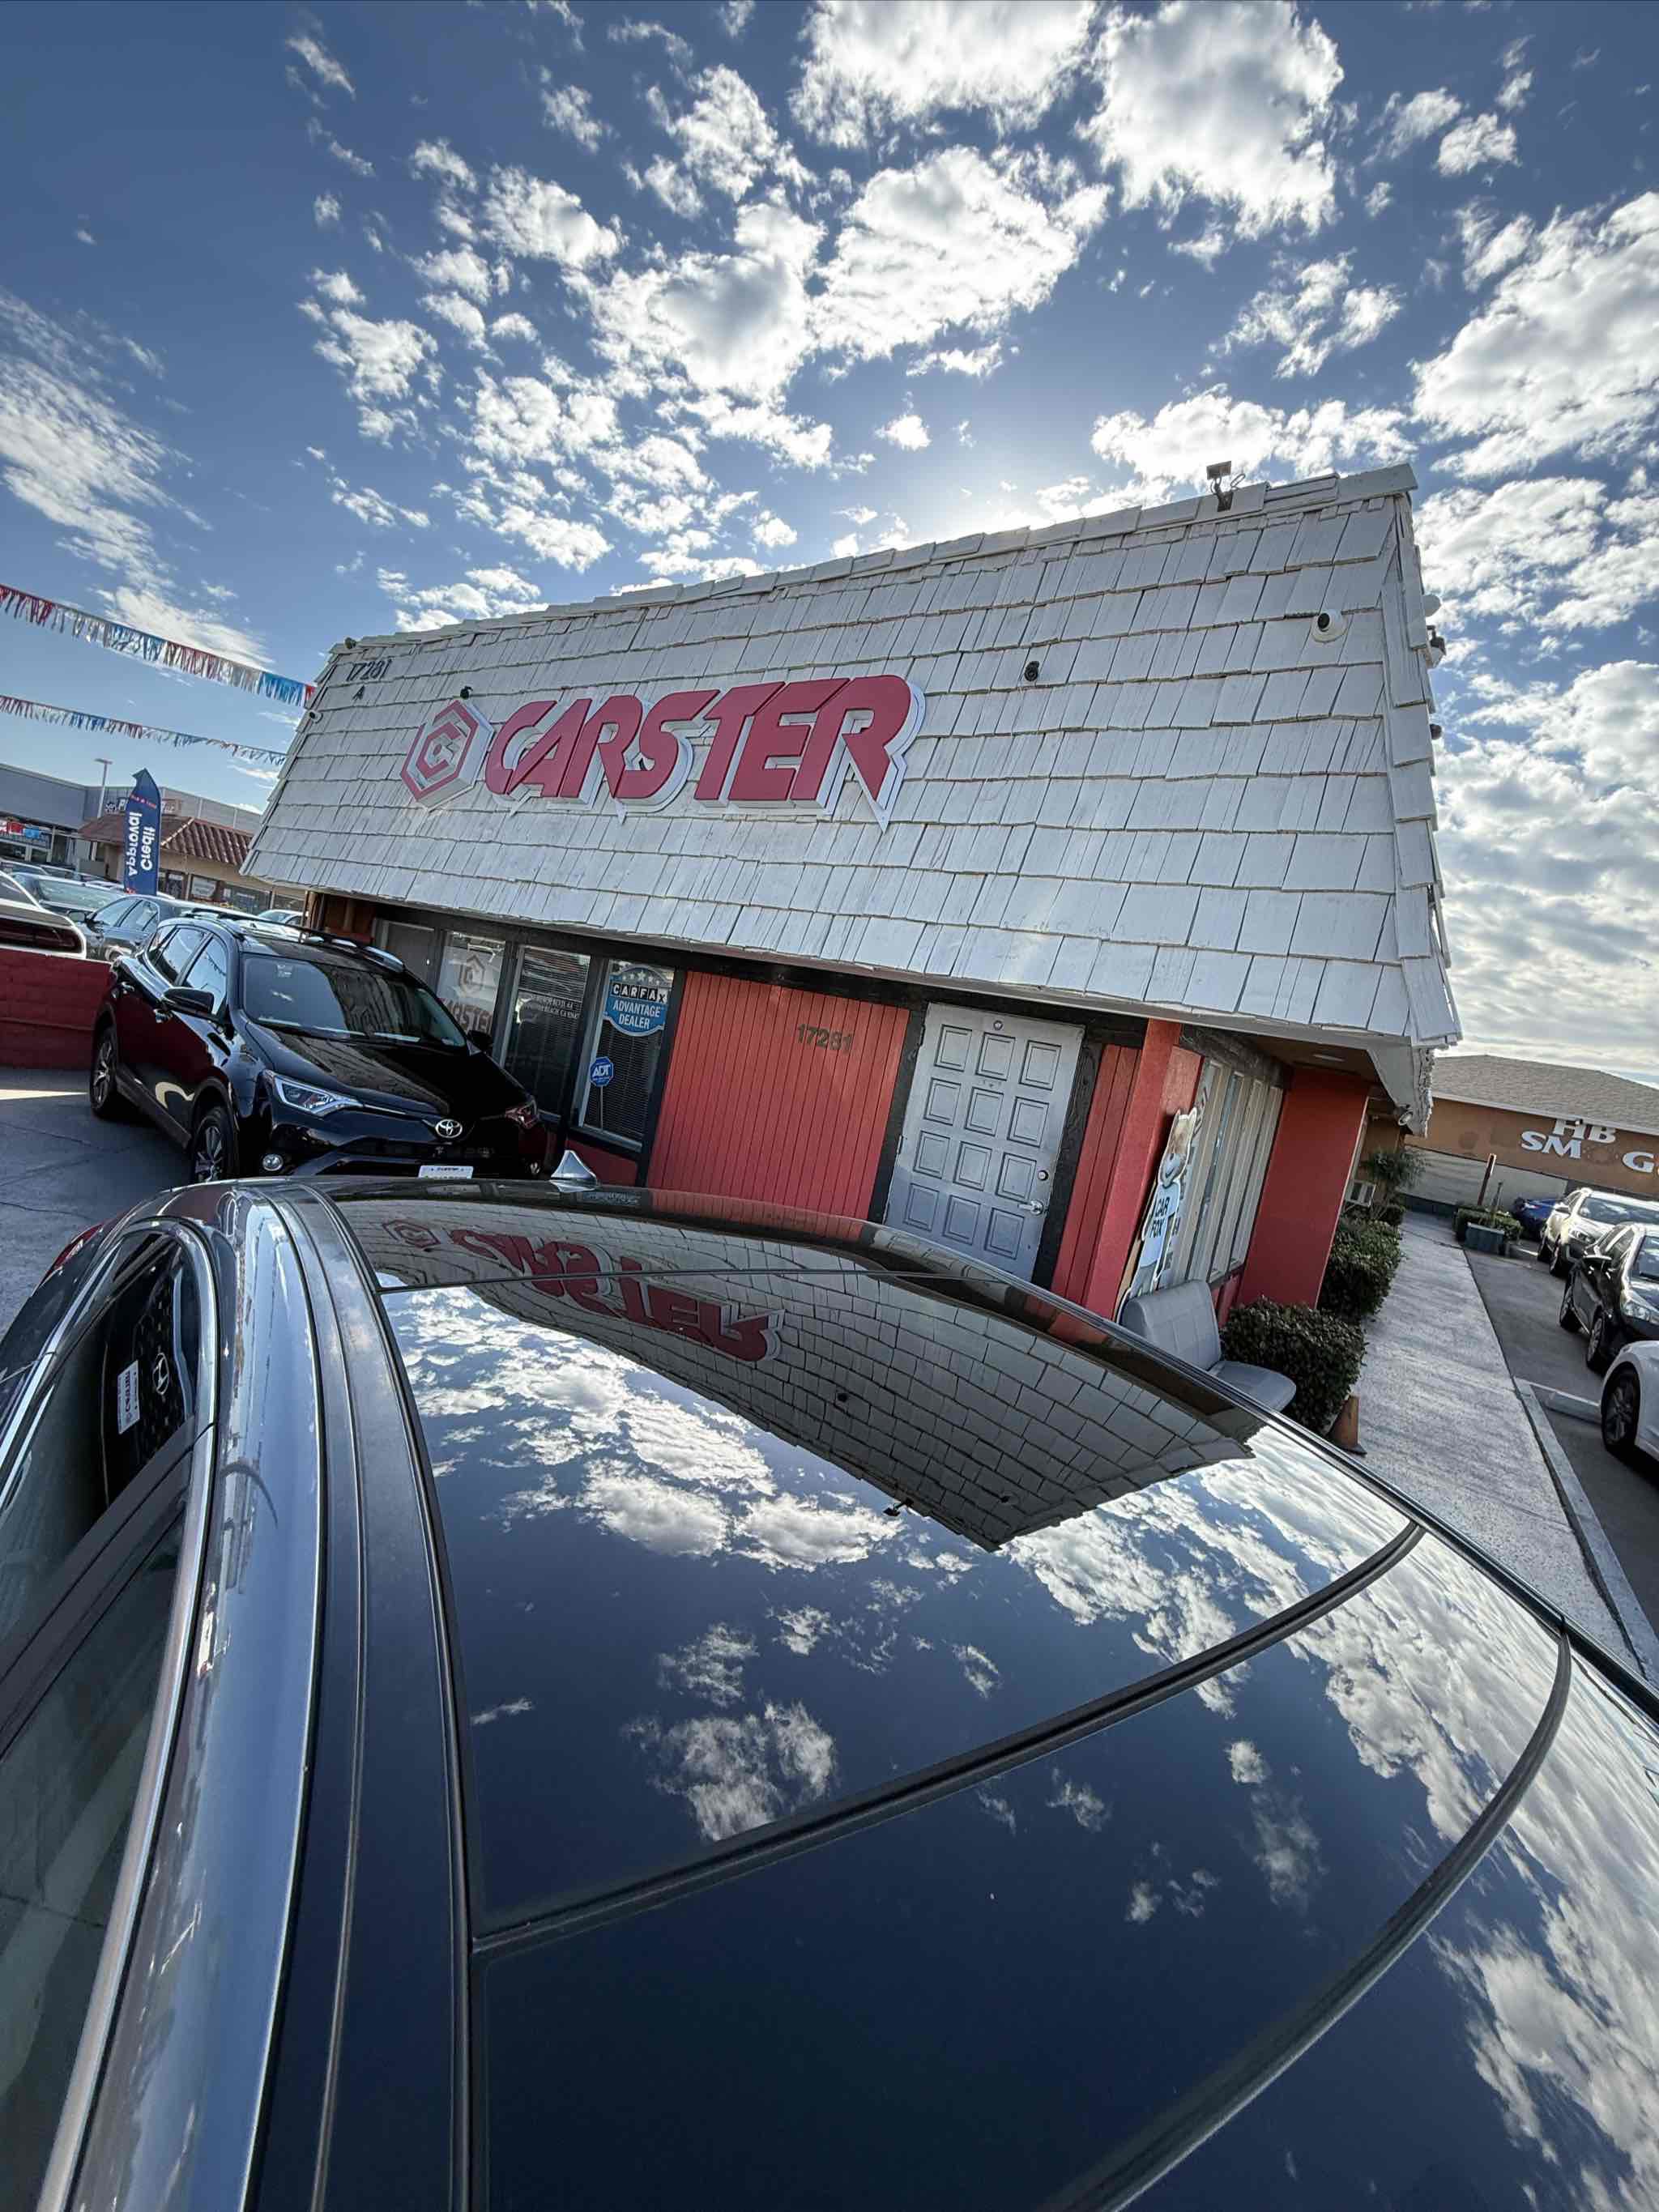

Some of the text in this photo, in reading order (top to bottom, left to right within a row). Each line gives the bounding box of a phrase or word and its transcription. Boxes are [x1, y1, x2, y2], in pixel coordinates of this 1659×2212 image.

[346, 658, 392, 682] 17281
[486, 674, 915, 806] CARSTER
[612, 982, 667, 1004] CARFAX
[612, 999, 661, 1019] ADVANTAGE
[618, 1012, 650, 1030] DEALER
[797, 1023, 852, 1052] 17281
[591, 1064, 612, 1077] ADT
[1553, 1118, 1616, 1144] HB
[1520, 1130, 1655, 1174] SMG
[1154, 1196, 1171, 1217] CAR
[1149, 1217, 1166, 1238] FOX
